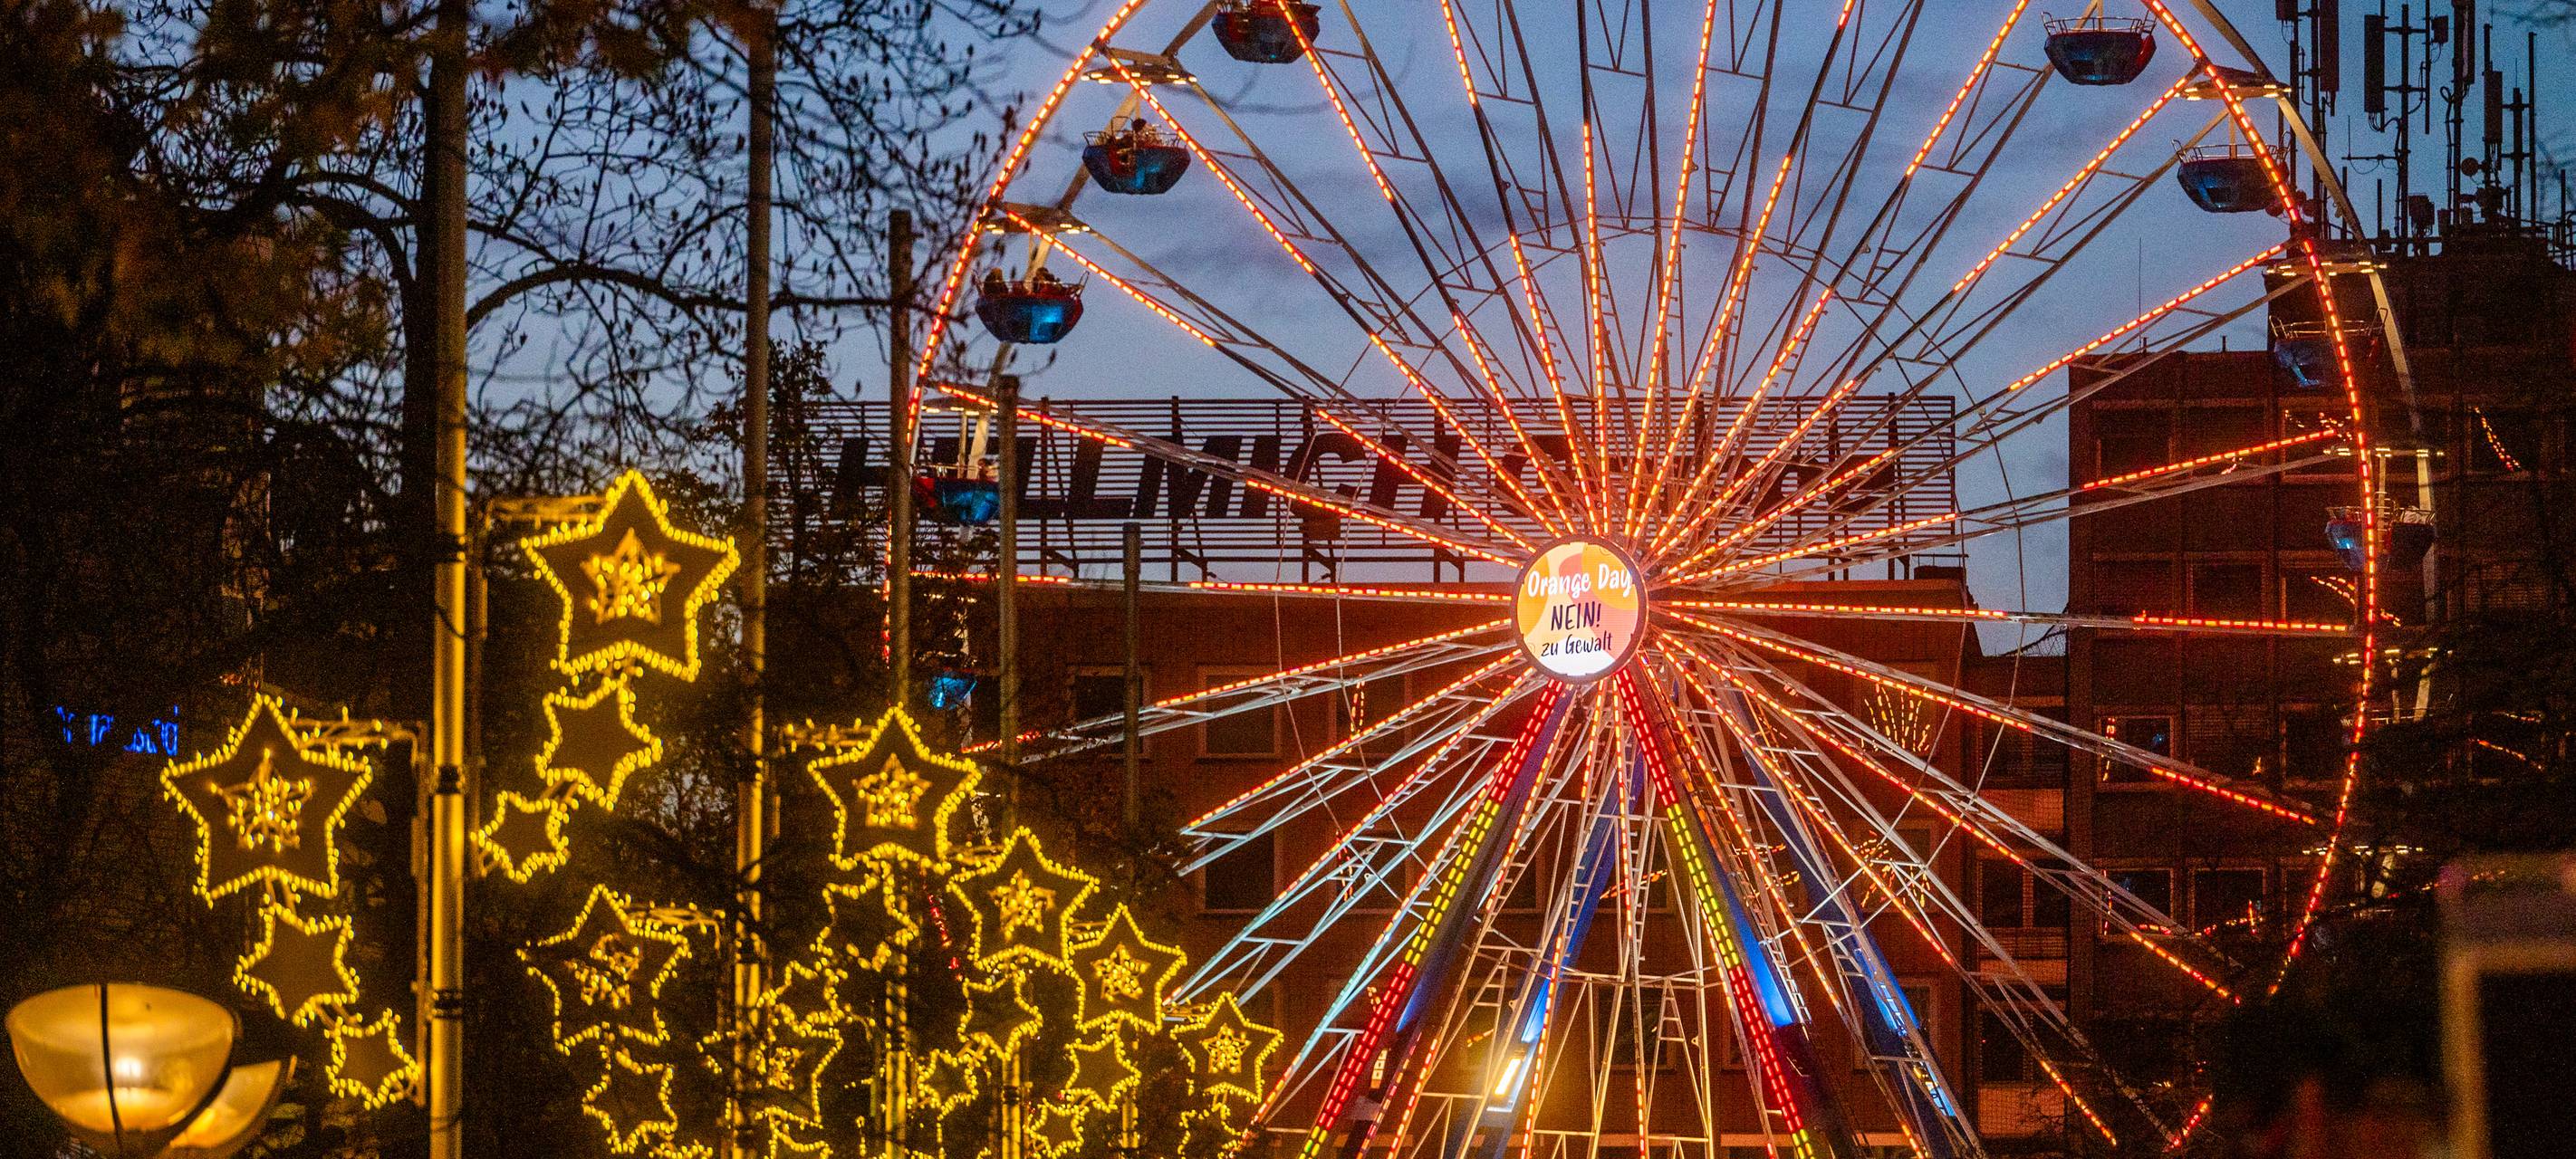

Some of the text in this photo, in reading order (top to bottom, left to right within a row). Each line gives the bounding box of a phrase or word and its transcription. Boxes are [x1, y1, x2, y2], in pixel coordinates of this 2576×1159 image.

[1527, 563, 1633, 599] Orange Day
[1551, 601, 1602, 631] NEIN!
[1541, 630, 1613, 657] zu Gewalt
